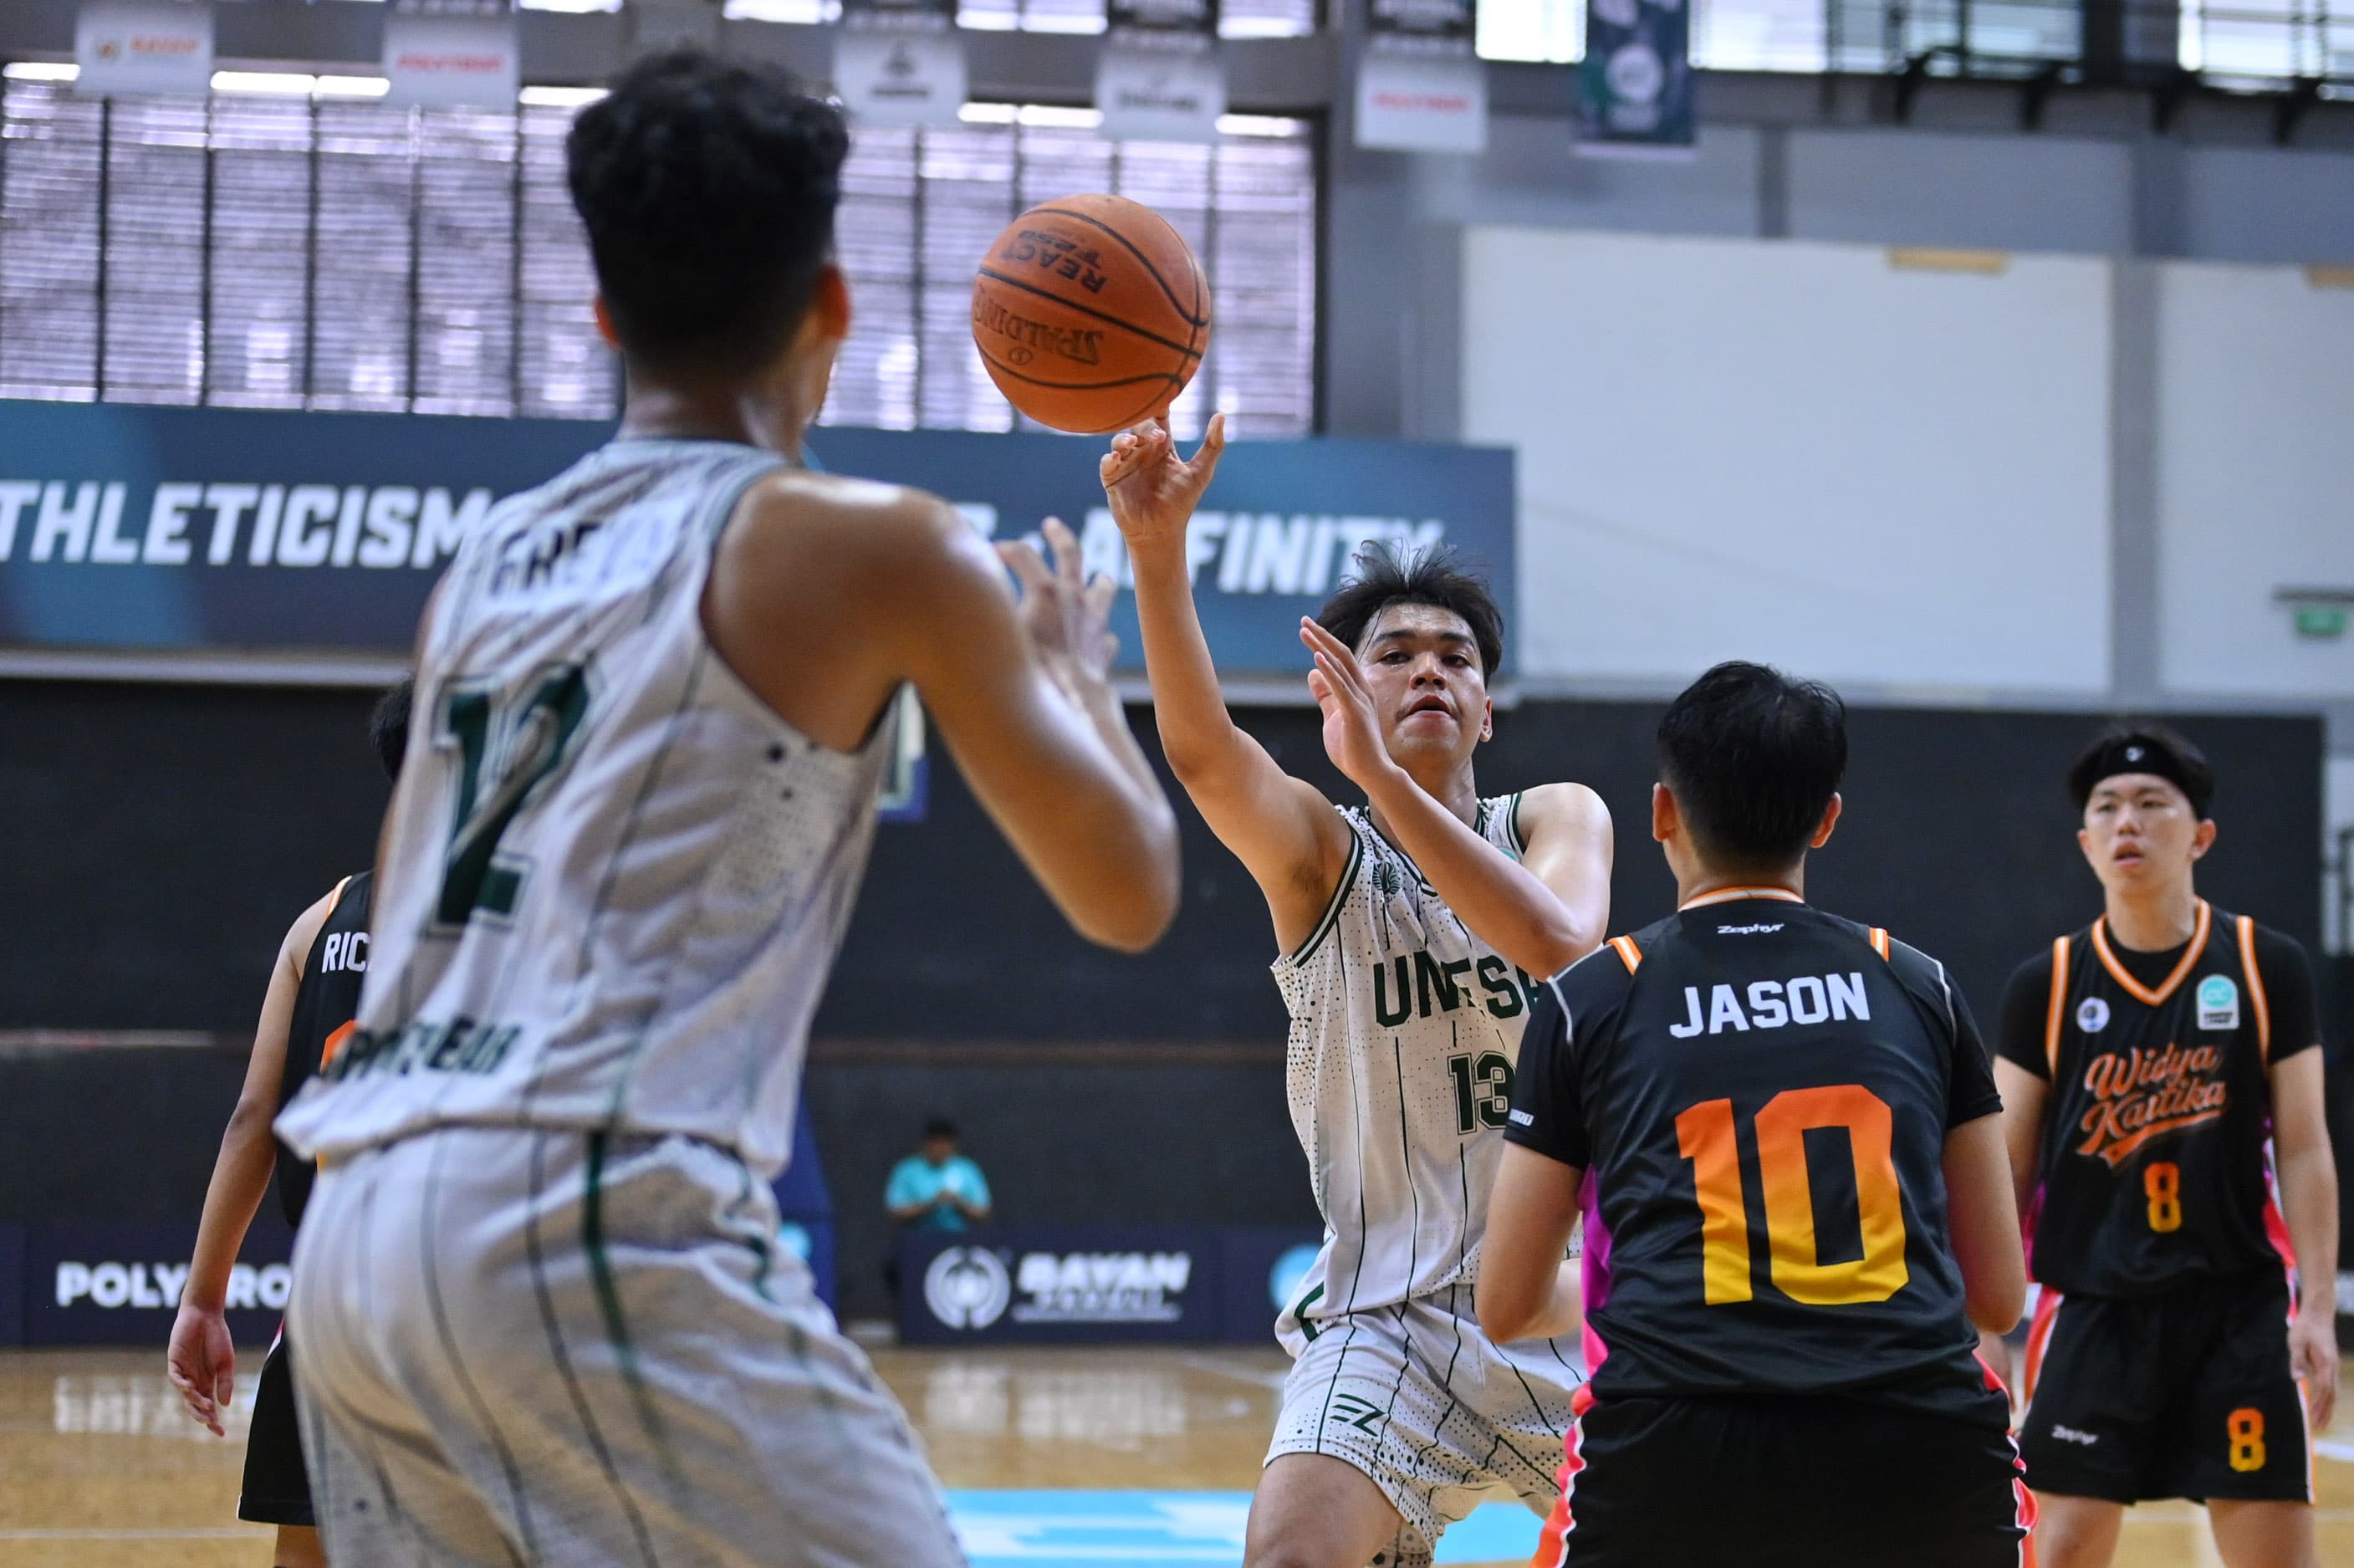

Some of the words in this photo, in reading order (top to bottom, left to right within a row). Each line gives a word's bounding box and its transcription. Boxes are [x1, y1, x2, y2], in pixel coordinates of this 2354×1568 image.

[1001, 238, 1107, 293] REACT
[1079, 505, 1445, 595] AFINITY
[432, 656, 604, 935] 12
[321, 931, 371, 973] RIC
[1717, 923, 1785, 935] Zephyr
[1669, 973, 1871, 1038] JASON
[1448, 1050, 1516, 1135] 13
[2084, 1042, 2219, 1100] Widya
[1675, 1085, 1909, 1305] 10
[2144, 1162, 2182, 1232] 8
[55, 1261, 289, 1308] POLYRO
[2228, 1407, 2266, 1472] 8
